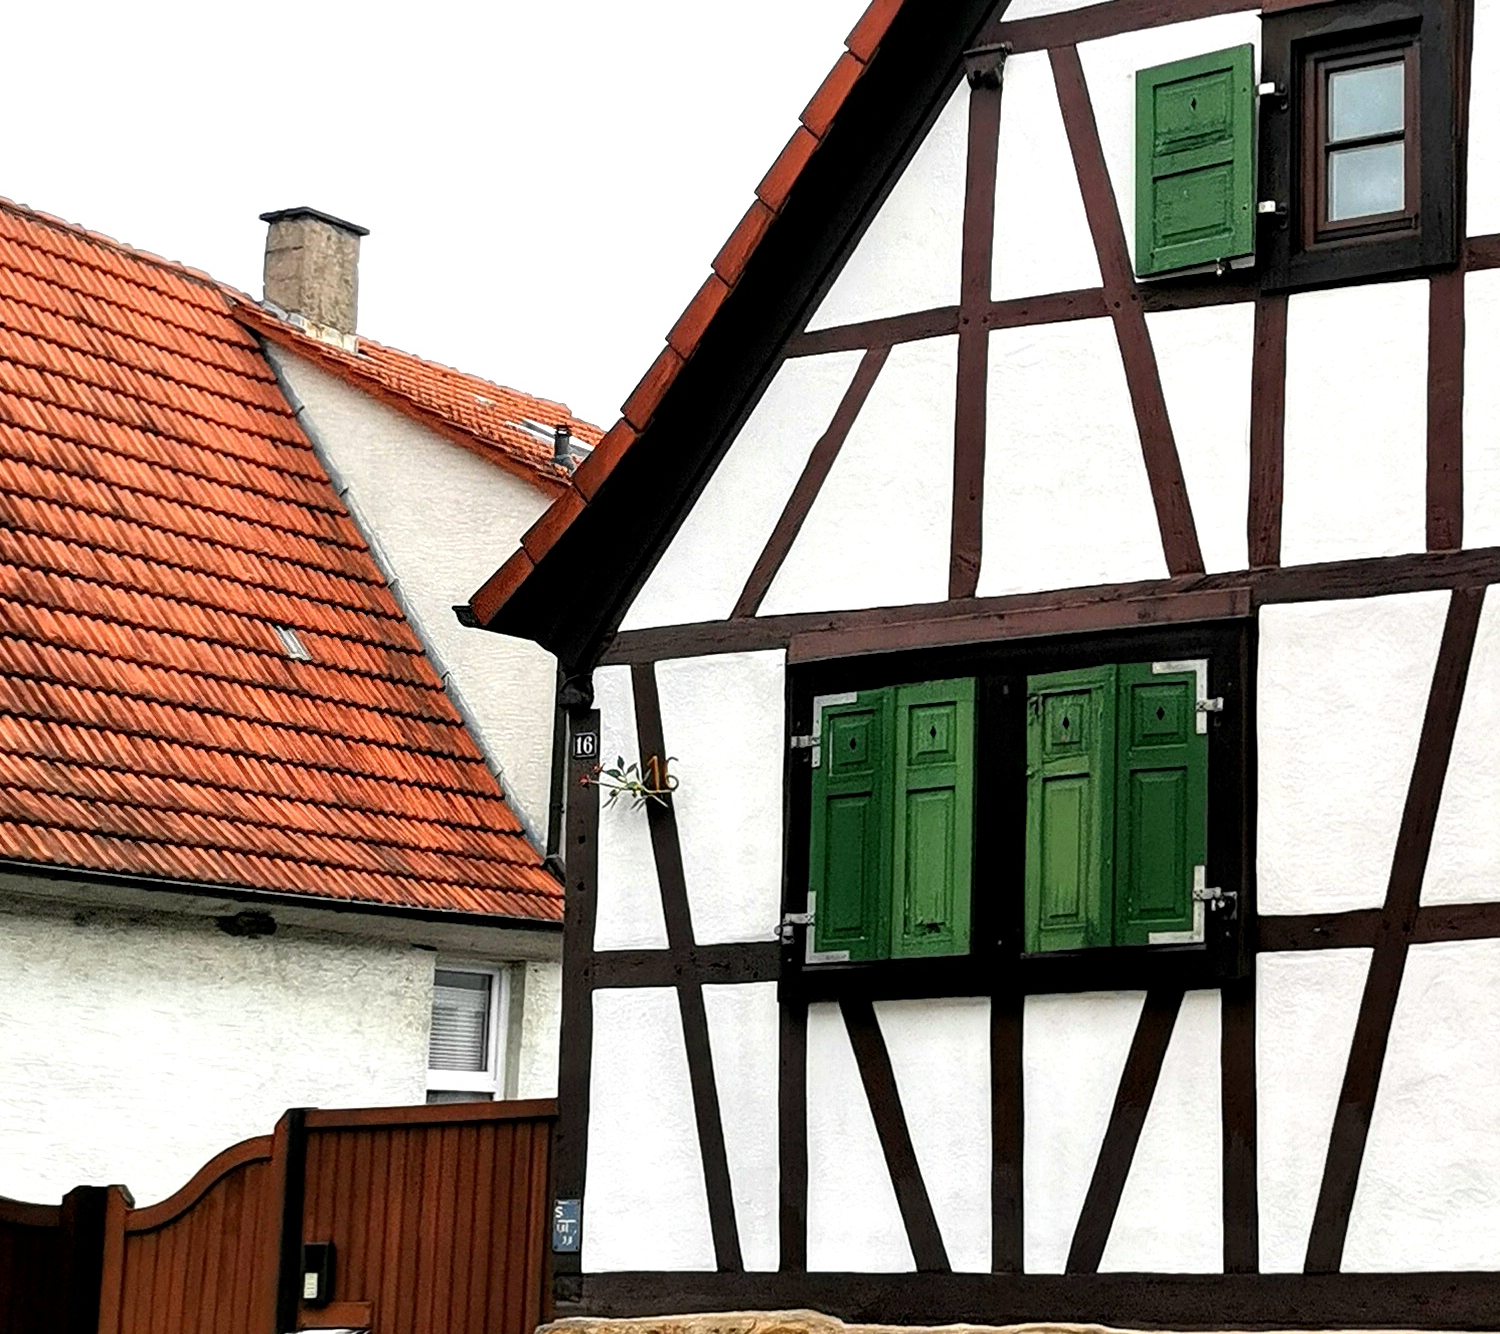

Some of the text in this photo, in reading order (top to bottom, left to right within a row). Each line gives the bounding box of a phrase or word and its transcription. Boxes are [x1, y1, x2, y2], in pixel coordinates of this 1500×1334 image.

[576, 736, 593, 754] 16
[647, 755, 679, 793] 16
[554, 1206, 564, 1218] S
